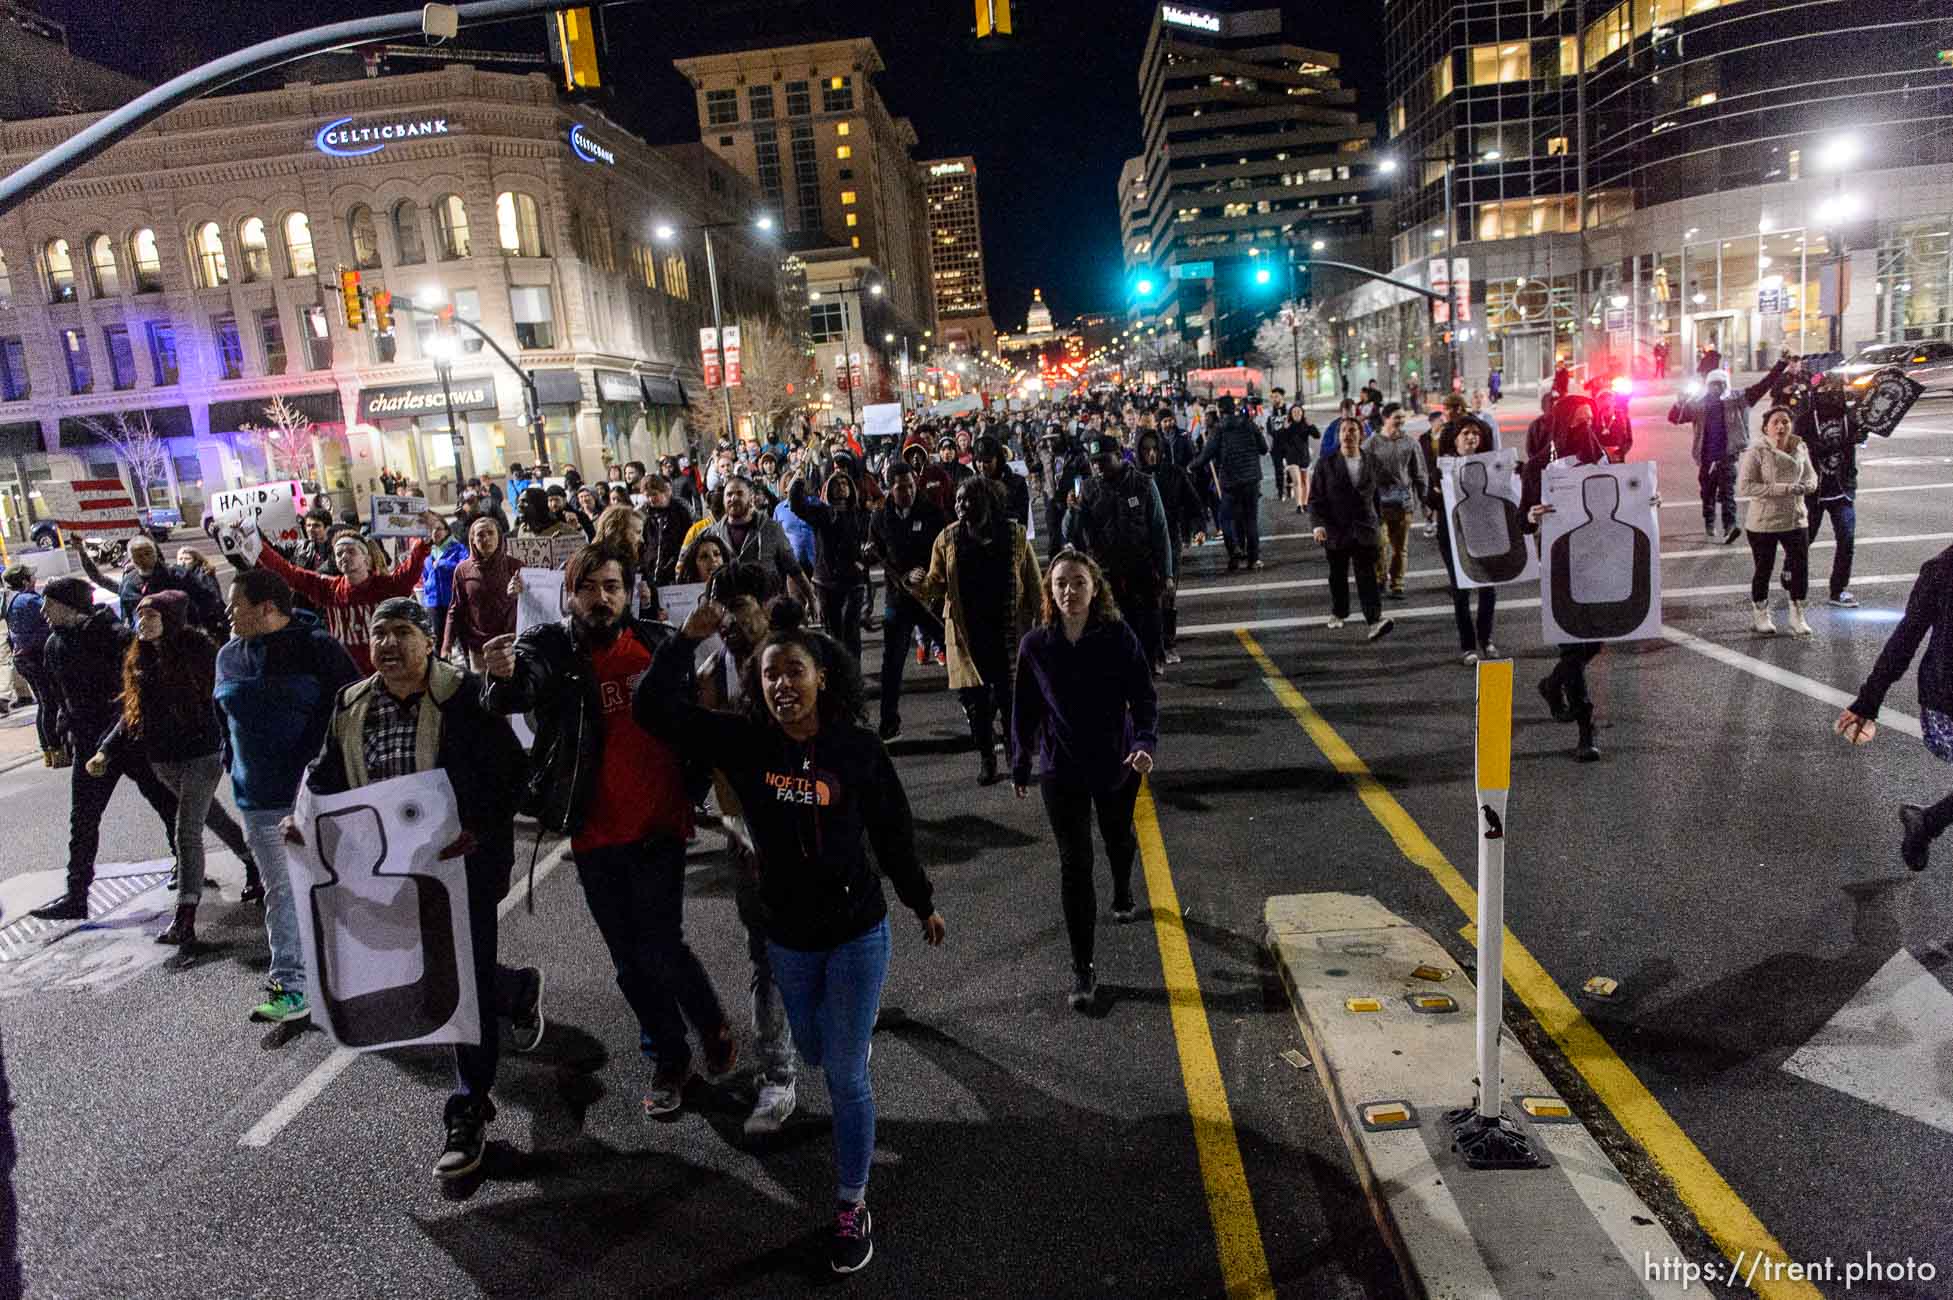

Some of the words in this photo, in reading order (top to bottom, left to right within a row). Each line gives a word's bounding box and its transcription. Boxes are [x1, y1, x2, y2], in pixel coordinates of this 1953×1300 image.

[326, 119, 448, 145] CELTICBANK
[369, 390, 425, 412] charles
[219, 488, 280, 513] HANDS
[239, 506, 262, 521] UP
[776, 787, 814, 805] FACE
